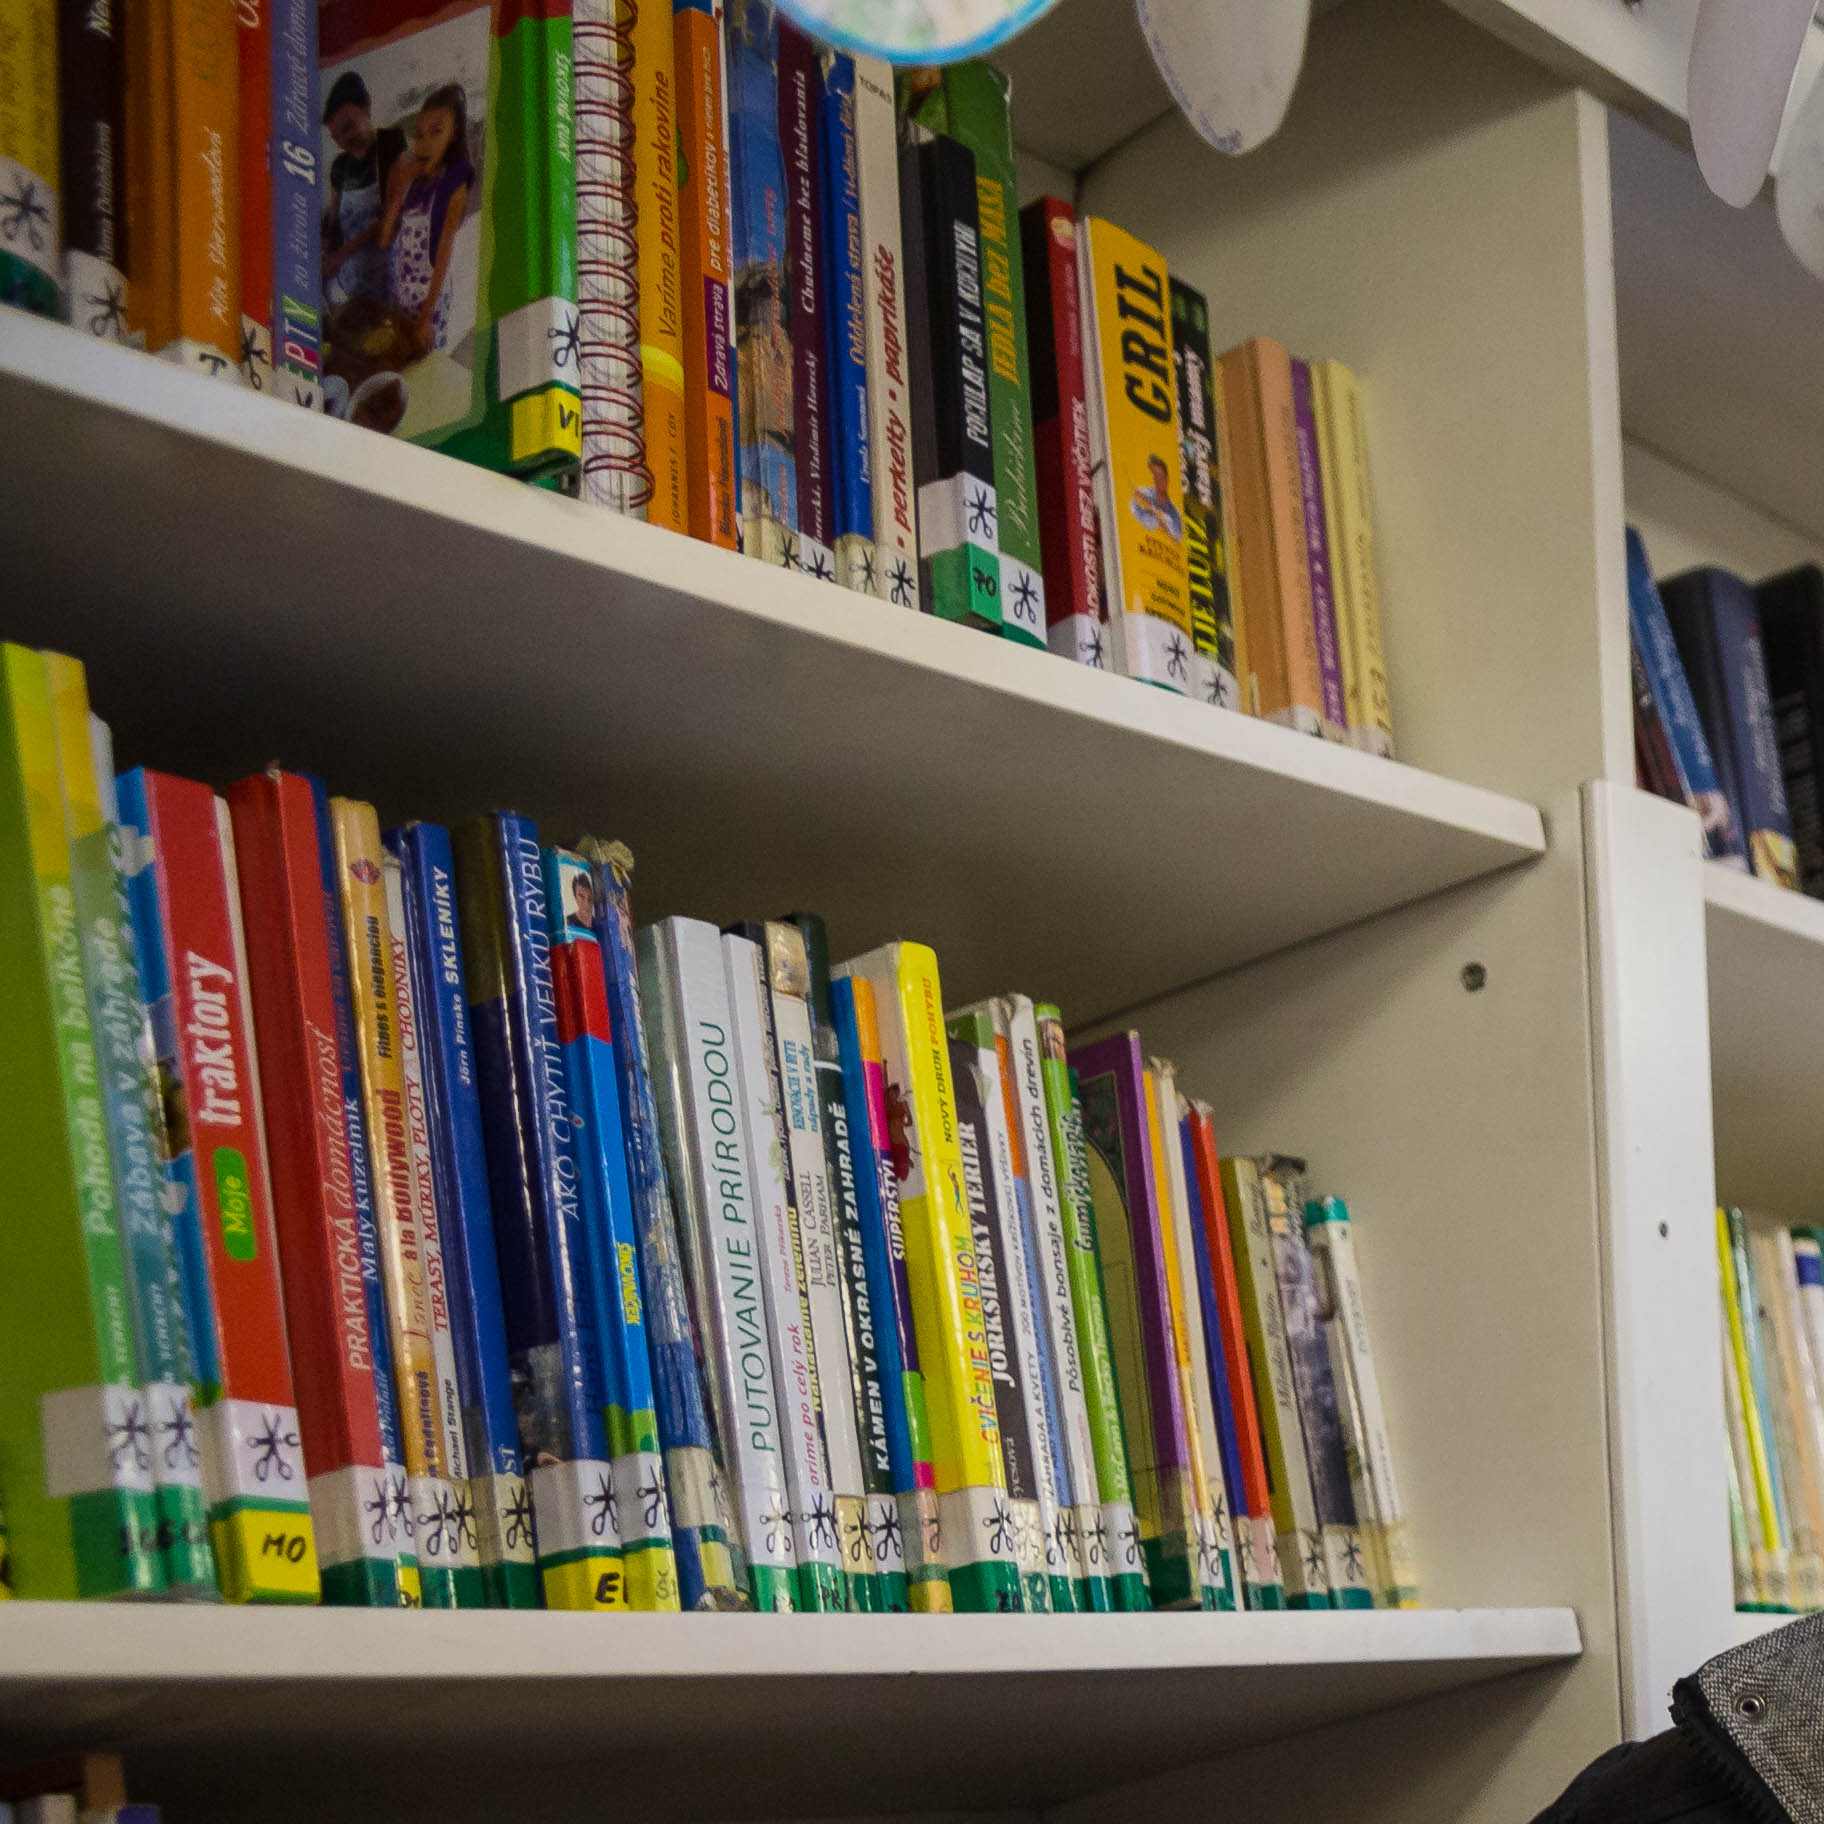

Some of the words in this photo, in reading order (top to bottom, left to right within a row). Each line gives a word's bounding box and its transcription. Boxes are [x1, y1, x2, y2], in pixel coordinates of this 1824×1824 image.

[651, 72, 673, 183] rakovine
[792, 72, 810, 173] hladovania
[282, 140, 316, 185] 16
[703, 142, 721, 237] diabetikov
[795, 178, 812, 210] bez
[653, 185, 675, 248] proti
[846, 214, 861, 269] strava
[705, 242, 723, 272] pre
[797, 213, 815, 313] Chudneme
[985, 250, 1012, 301] bez
[655, 251, 677, 339] Varíme
[710, 283, 726, 333] strava
[844, 272, 865, 365] Oddelená
[875, 245, 900, 383] paprikáše
[958, 304, 982, 321] V
[711, 334, 729, 391] Zdravá
[959, 324, 983, 354] SA
[1116, 263, 1171, 423] GRIL
[884, 410, 911, 533] perkelty
[1077, 488, 1094, 531] BEZ
[517, 837, 549, 920] RYBU
[47, 884, 87, 1030] balkóne
[431, 864, 461, 986] SKLENÍKY
[93, 915, 134, 1060] záhrade
[388, 934, 417, 1052] CHODNÍKY
[450, 993, 466, 1045] Pinske
[921, 976, 938, 1045] POHYBU
[68, 1041, 98, 1086] na
[185, 949, 243, 1127] traktory
[457, 1049, 471, 1085] Jörn
[929, 1049, 948, 1094] DRUH
[1020, 1037, 1041, 1100] drevín
[117, 1071, 138, 1092] v
[404, 1077, 426, 1148] PLOTY
[539, 1034, 582, 1144] CHYTIŤ
[306, 1023, 352, 1210] domácnosť
[698, 1020, 749, 1225] PRÍRODOU
[936, 1098, 953, 1143] NOVÝ
[71, 1095, 116, 1236] Pohoda
[117, 1102, 158, 1236] Zábava
[377, 1088, 415, 1223] Bollywood
[828, 1102, 859, 1222] ZAHRADĚ
[957, 1121, 988, 1217] TERIER
[1029, 1105, 1057, 1199] domácich
[222, 1174, 249, 1236] Moje
[408, 1152, 440, 1243] MÚRIKY,
[555, 1156, 582, 1221] AKO
[798, 1170, 816, 1231] CASSELL
[813, 1171, 832, 1236] PARHAM
[1043, 1203, 1055, 1215] z
[356, 1215, 379, 1281] Malý
[804, 1237, 825, 1288] JULIAN
[822, 1241, 837, 1287] PETER
[952, 1234, 984, 1325] KRUHOM
[1045, 1220, 1070, 1298] bonsaje
[333, 1217, 371, 1370] PRAKTICKÁ
[421, 1248, 450, 1332] TERASY,
[846, 1227, 876, 1349] OKRASNÉ
[726, 1236, 775, 1453] PUTOVANIE
[787, 1323, 801, 1354] rok
[966, 1330, 984, 1343] S
[1020, 1310, 1031, 1334] 200
[1055, 1302, 1082, 1392] Pôsobivé
[792, 1360, 808, 1396] celý
[863, 1356, 878, 1373] V
[969, 1347, 999, 1444] CVIČENIE
[1026, 1350, 1042, 1402] KVETY
[443, 1378, 458, 1426] Stange
[801, 1402, 815, 1427] po
[868, 1379, 890, 1471] KÁMEN
[1034, 1406, 1043, 1418] A
[262, 1533, 307, 1563] MO
